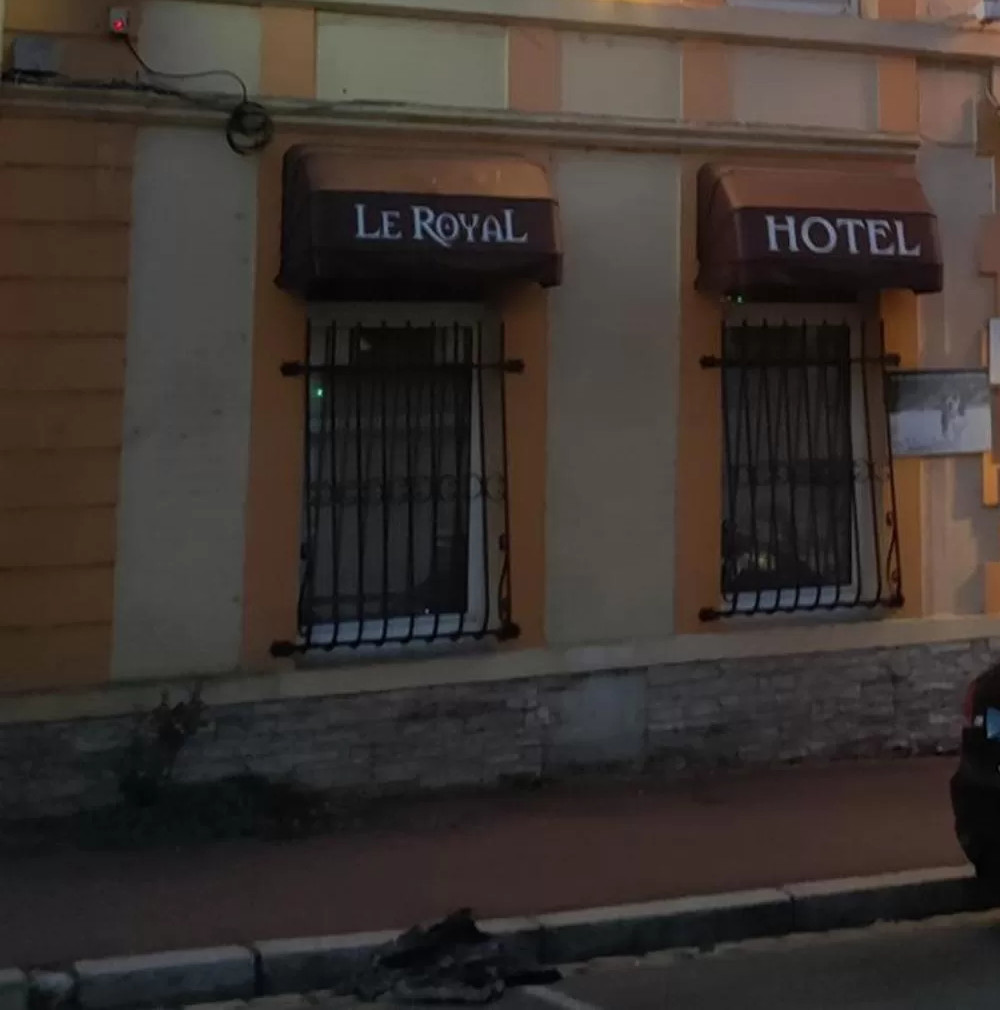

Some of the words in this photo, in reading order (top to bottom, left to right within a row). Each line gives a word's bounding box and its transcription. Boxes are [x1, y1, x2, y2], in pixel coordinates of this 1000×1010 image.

[355, 203, 402, 239] LE
[411, 205, 528, 248] ROYAL
[765, 214, 921, 257] HOTEL
